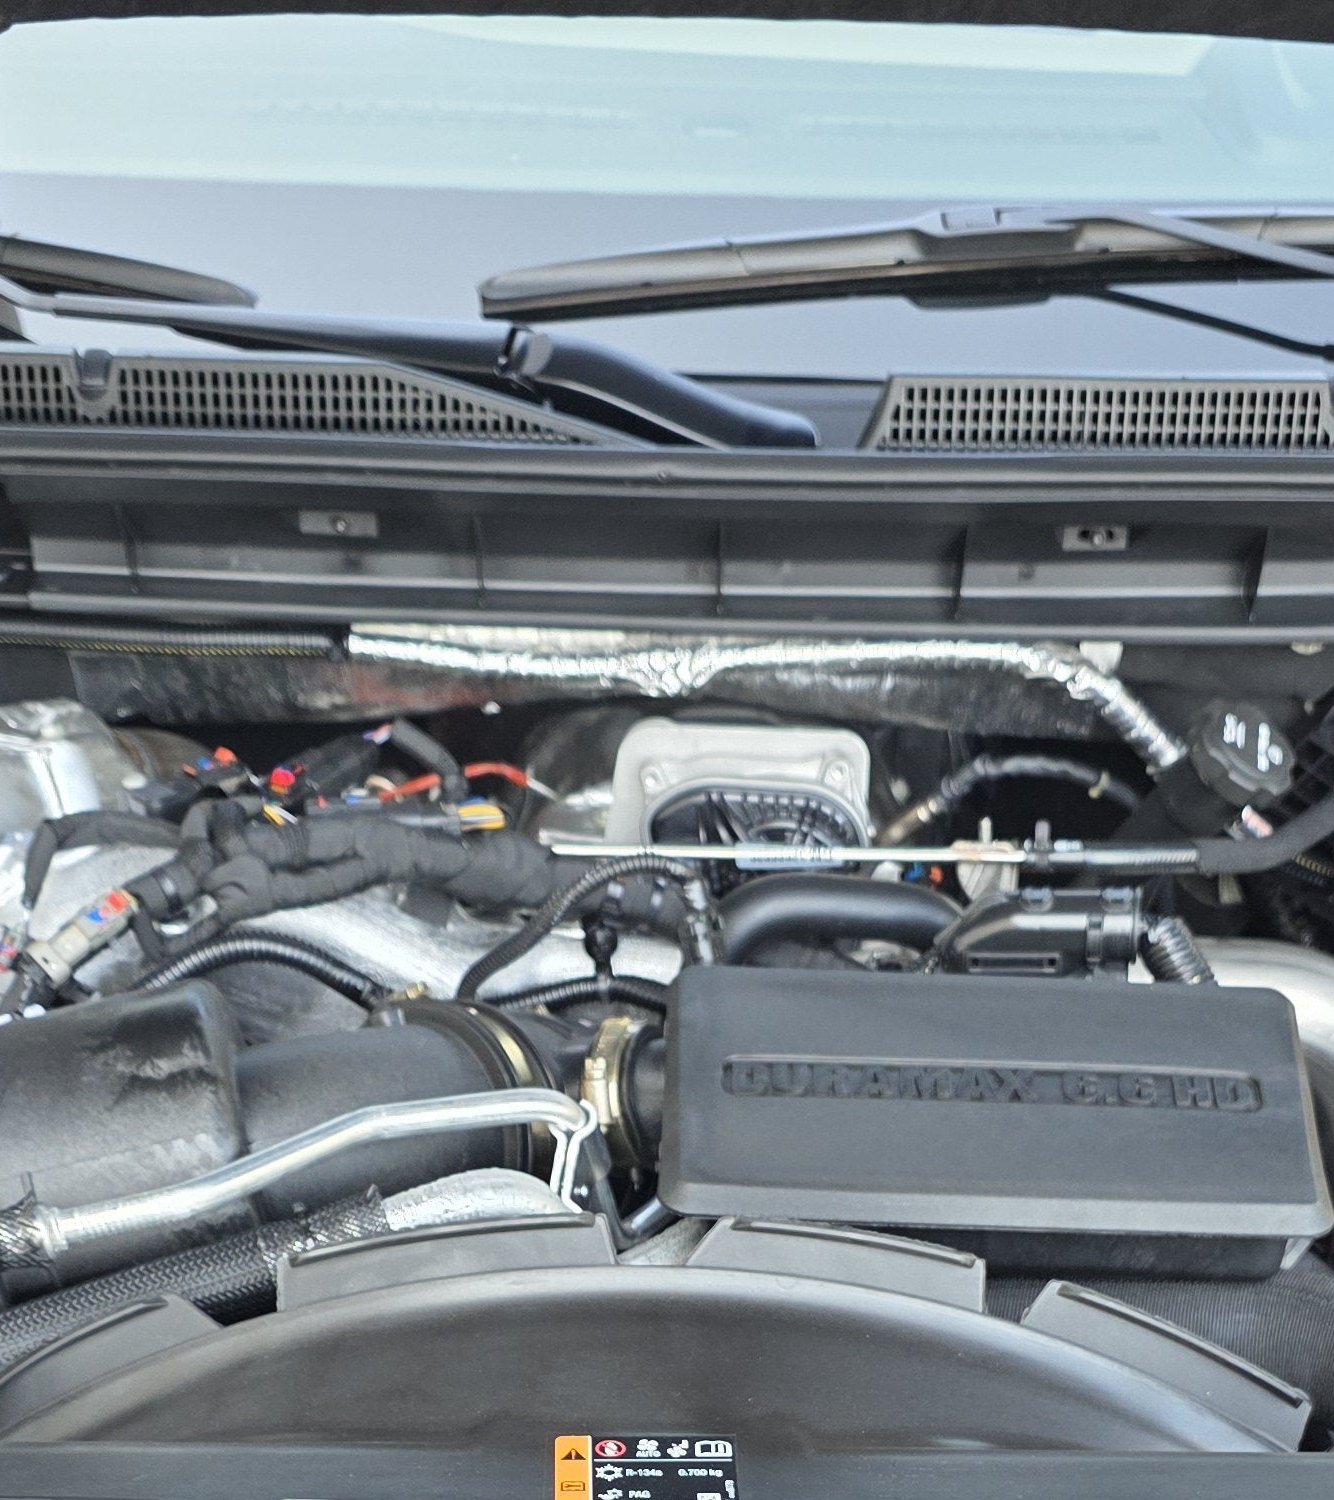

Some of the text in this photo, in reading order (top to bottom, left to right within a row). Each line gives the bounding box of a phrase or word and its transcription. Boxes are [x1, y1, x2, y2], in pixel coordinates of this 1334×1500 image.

[729, 1062, 1039, 1103] DURAMAX
[1170, 1075, 1259, 1112] HD
[625, 1468, 663, 1476] R-134a
[628, 1490, 651, 1498] PAG
